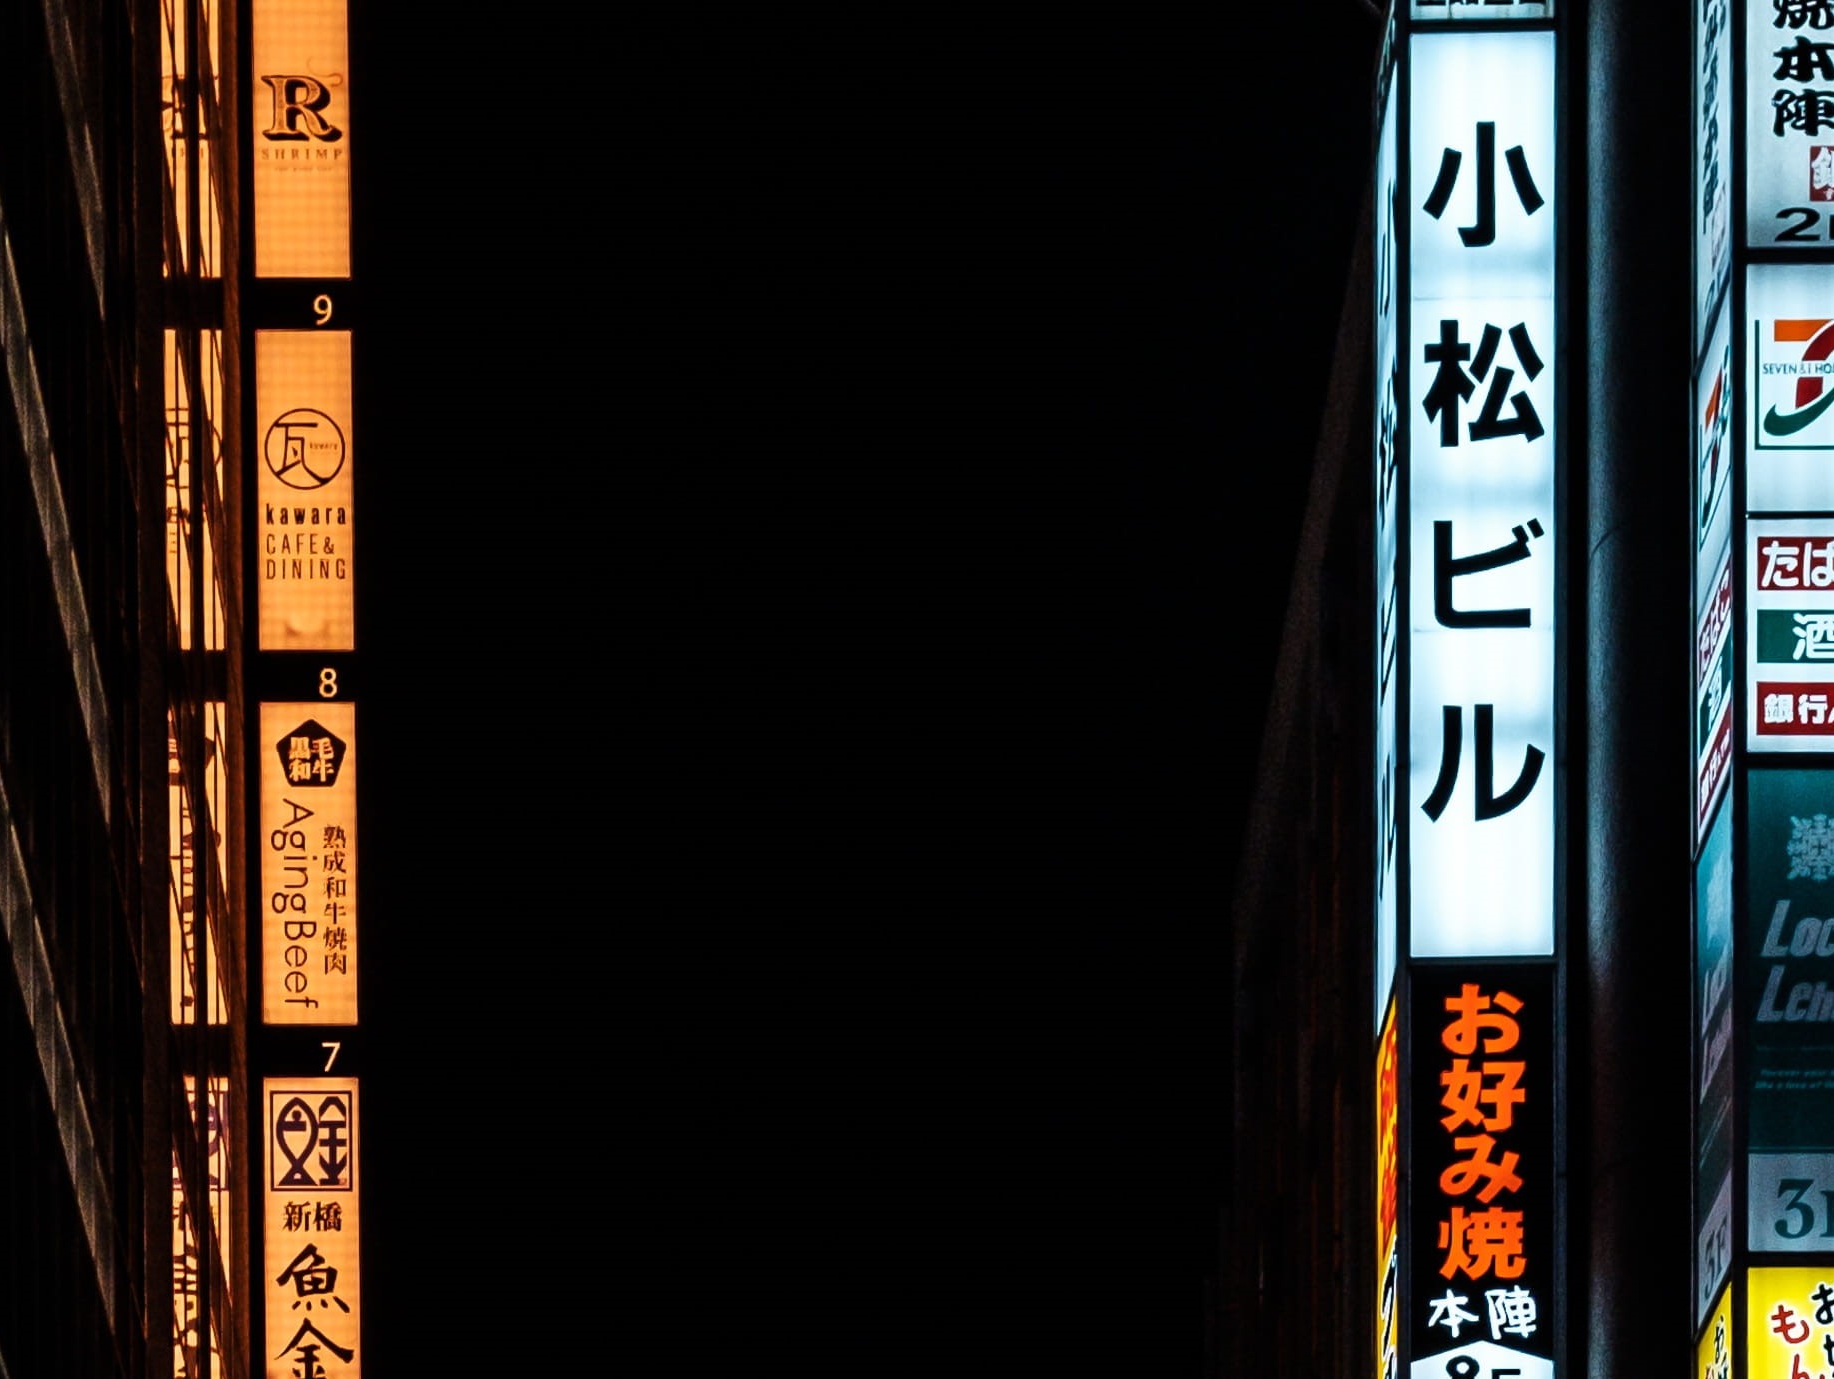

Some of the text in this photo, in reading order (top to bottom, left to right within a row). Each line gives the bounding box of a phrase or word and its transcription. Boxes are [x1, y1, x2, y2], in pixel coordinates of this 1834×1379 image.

[313, 295, 333, 324] 9
[1421, 120, 1547, 824] 小松ビル
[265, 503, 347, 527] kawara
[266, 558, 347, 580] DINING
[318, 667, 339, 698] 8
[322, 1042, 342, 1071] 7
[1437, 983, 1526, 1281] お好み焼
[282, 1200, 343, 1234] 新橋
[1427, 1286, 1537, 1340] 本陣
